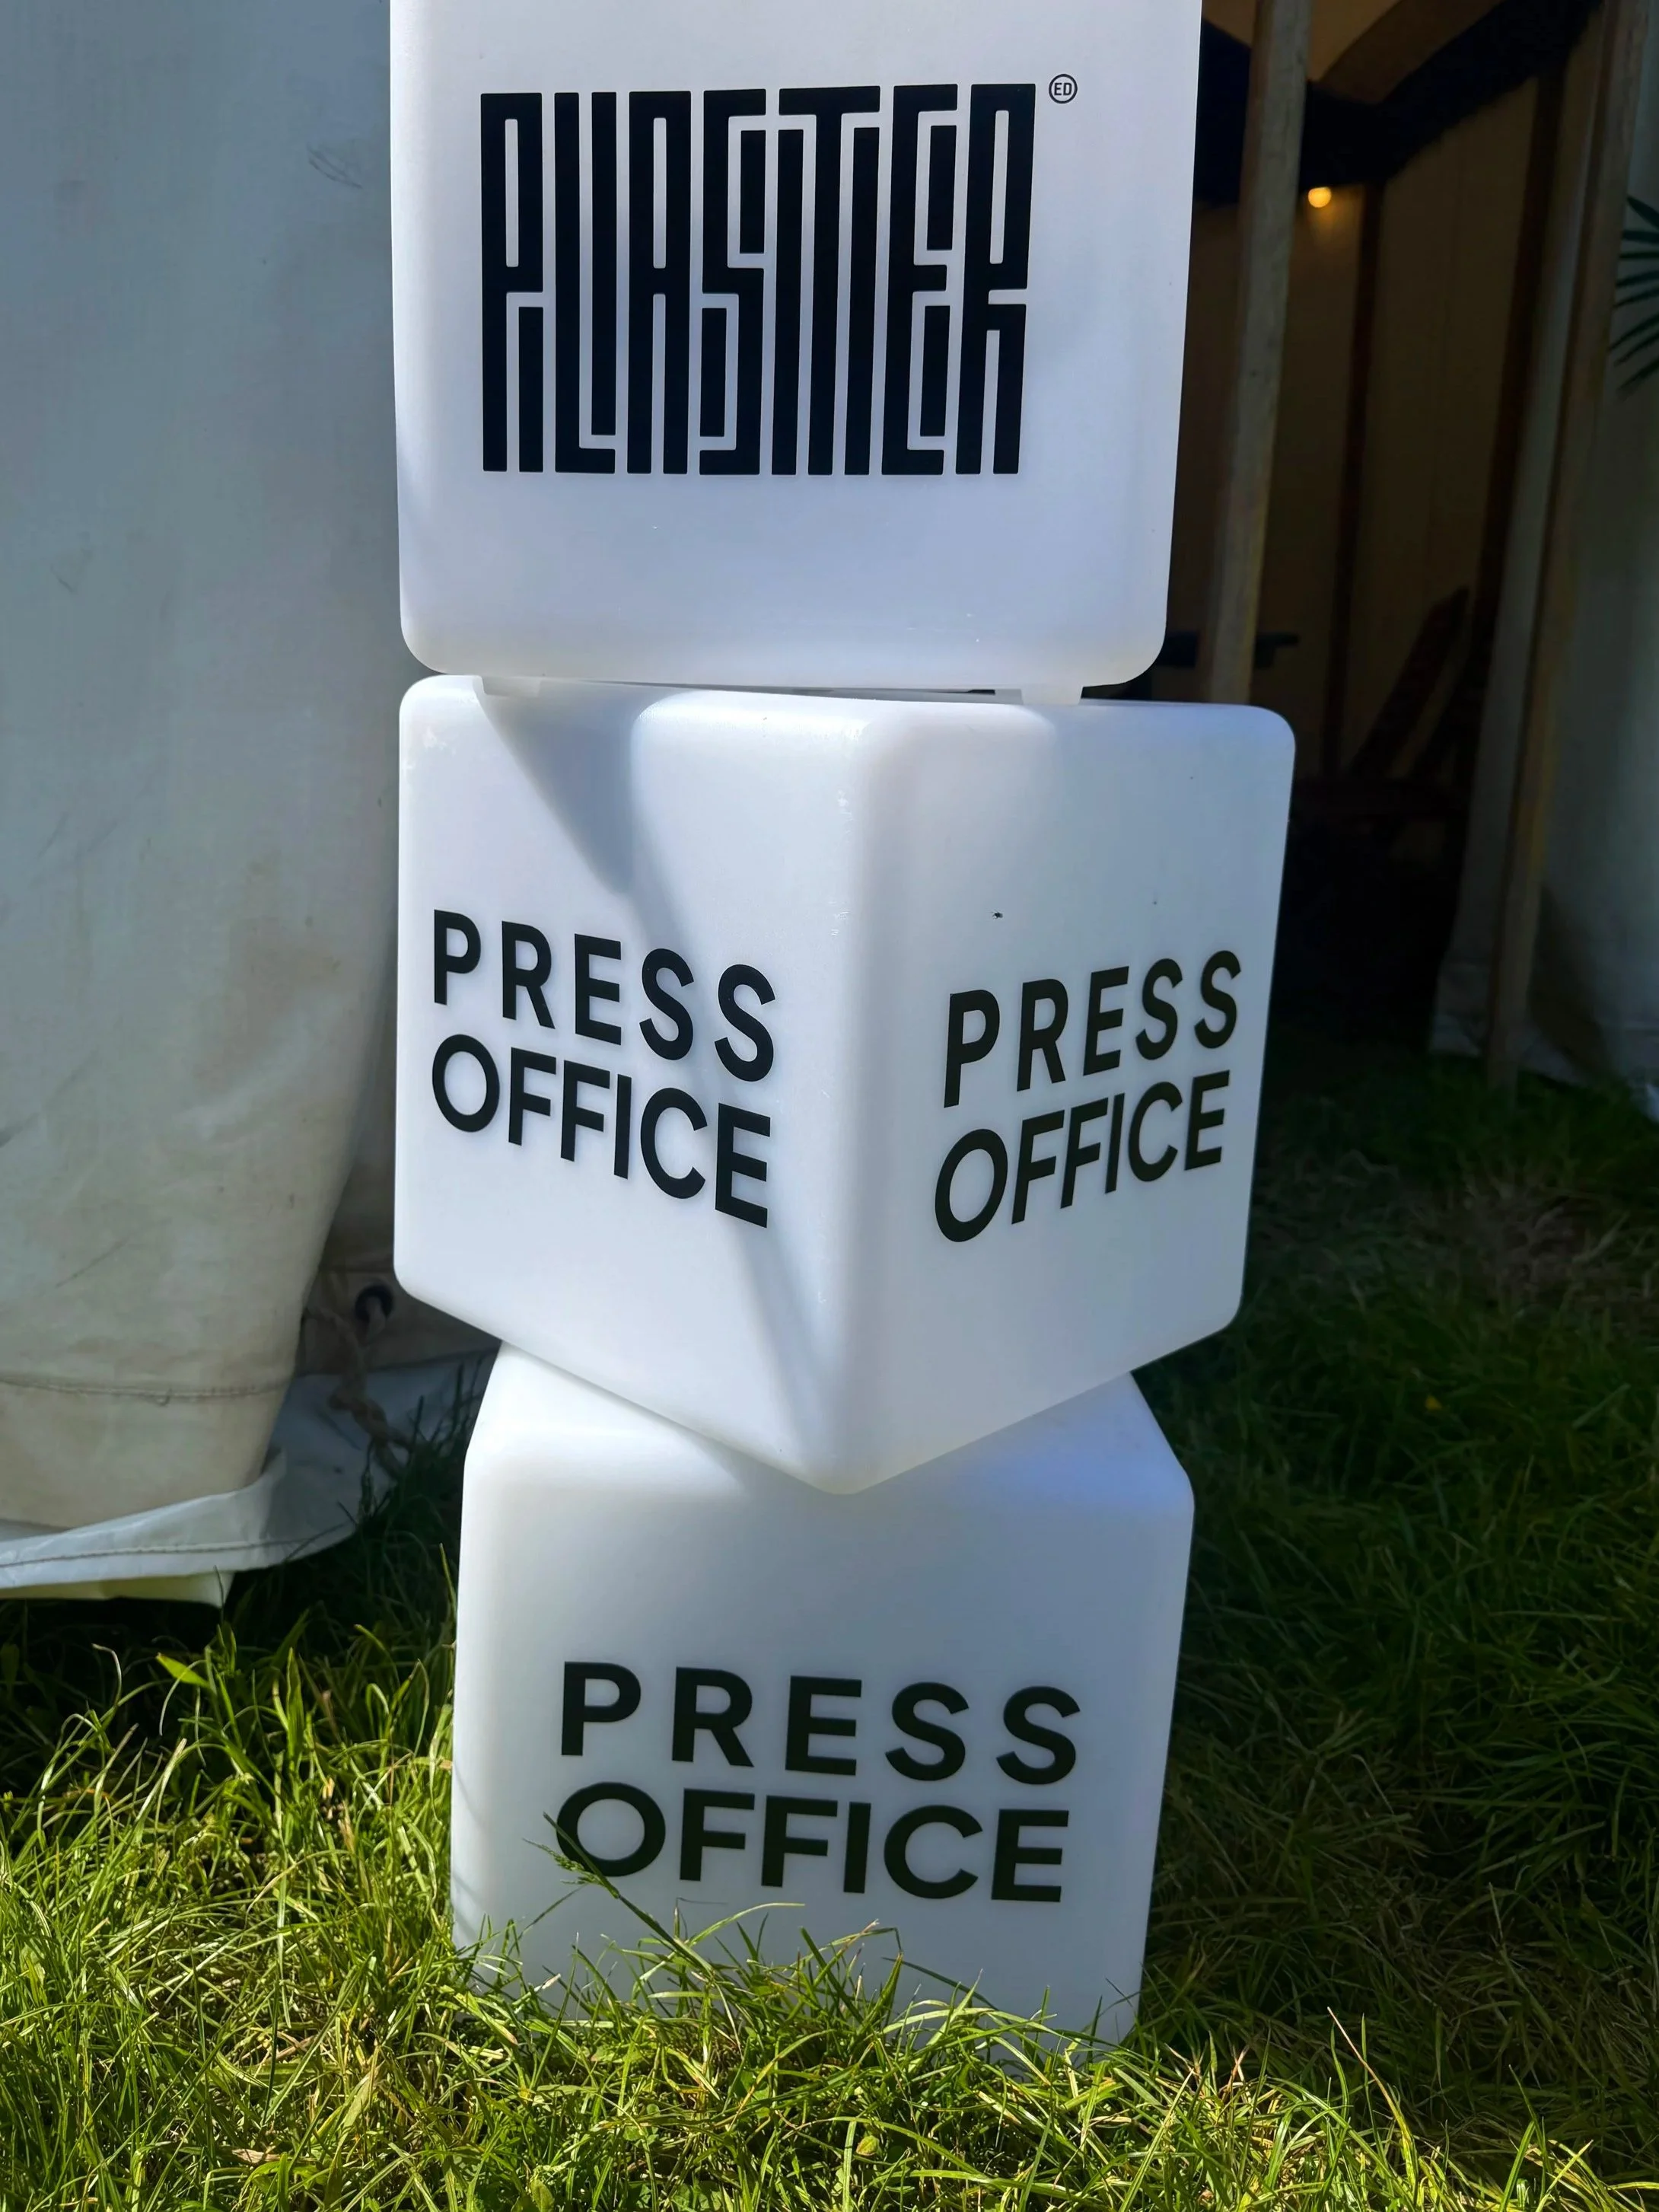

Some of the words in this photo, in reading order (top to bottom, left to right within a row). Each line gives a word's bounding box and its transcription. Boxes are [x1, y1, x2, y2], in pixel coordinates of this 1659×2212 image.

[1053, 82, 1073, 96] ED
[434, 909, 775, 1082] PRESS
[943, 950, 1242, 1108] PRESS
[431, 1034, 771, 1229] OFFICE
[935, 1069, 1231, 1243] OFFICE
[561, 1661, 1081, 1786] PRESS
[556, 1780, 1070, 1904] OFFICE
